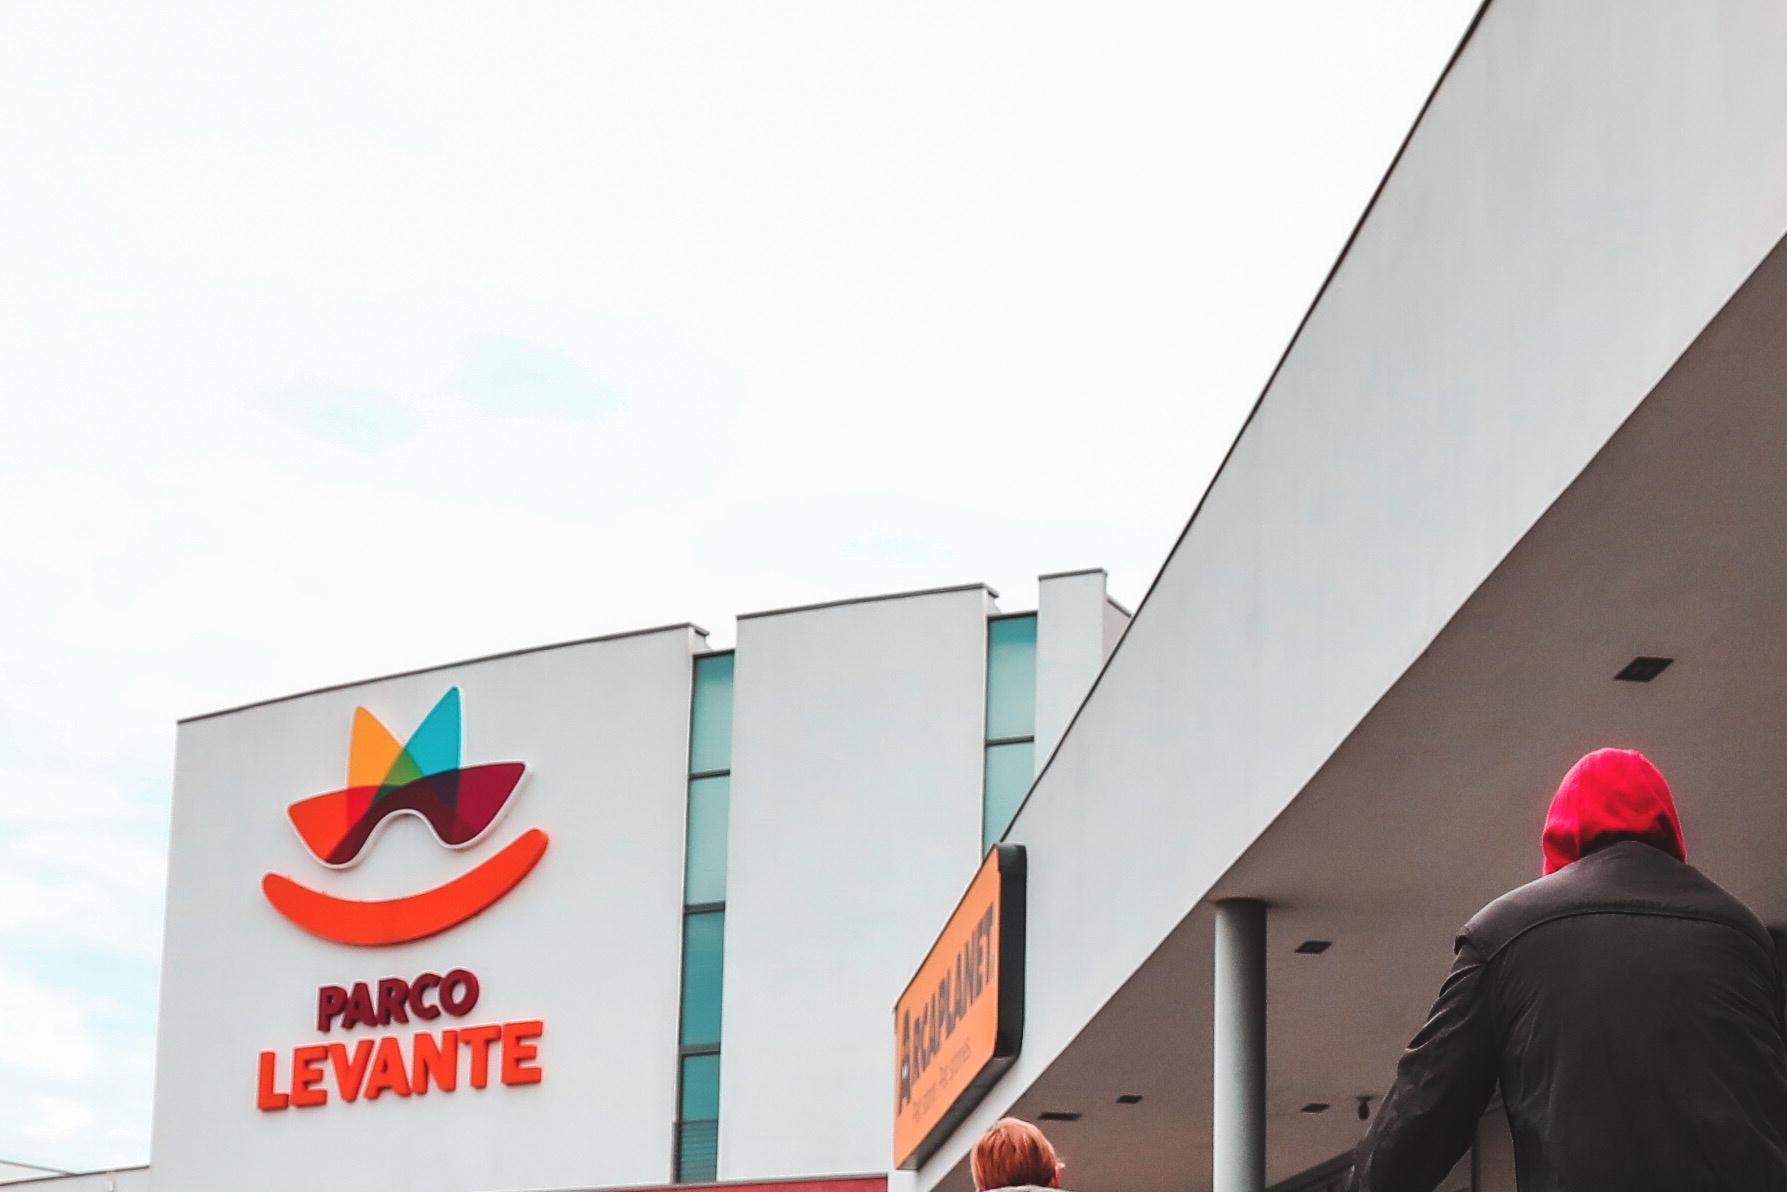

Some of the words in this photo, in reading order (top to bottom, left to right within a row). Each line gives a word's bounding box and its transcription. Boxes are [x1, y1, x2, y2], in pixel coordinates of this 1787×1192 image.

[316, 968, 480, 1032] PARCO
[898, 902, 995, 1118] ARCAPLANET
[257, 1020, 544, 1112] LEVANTE
